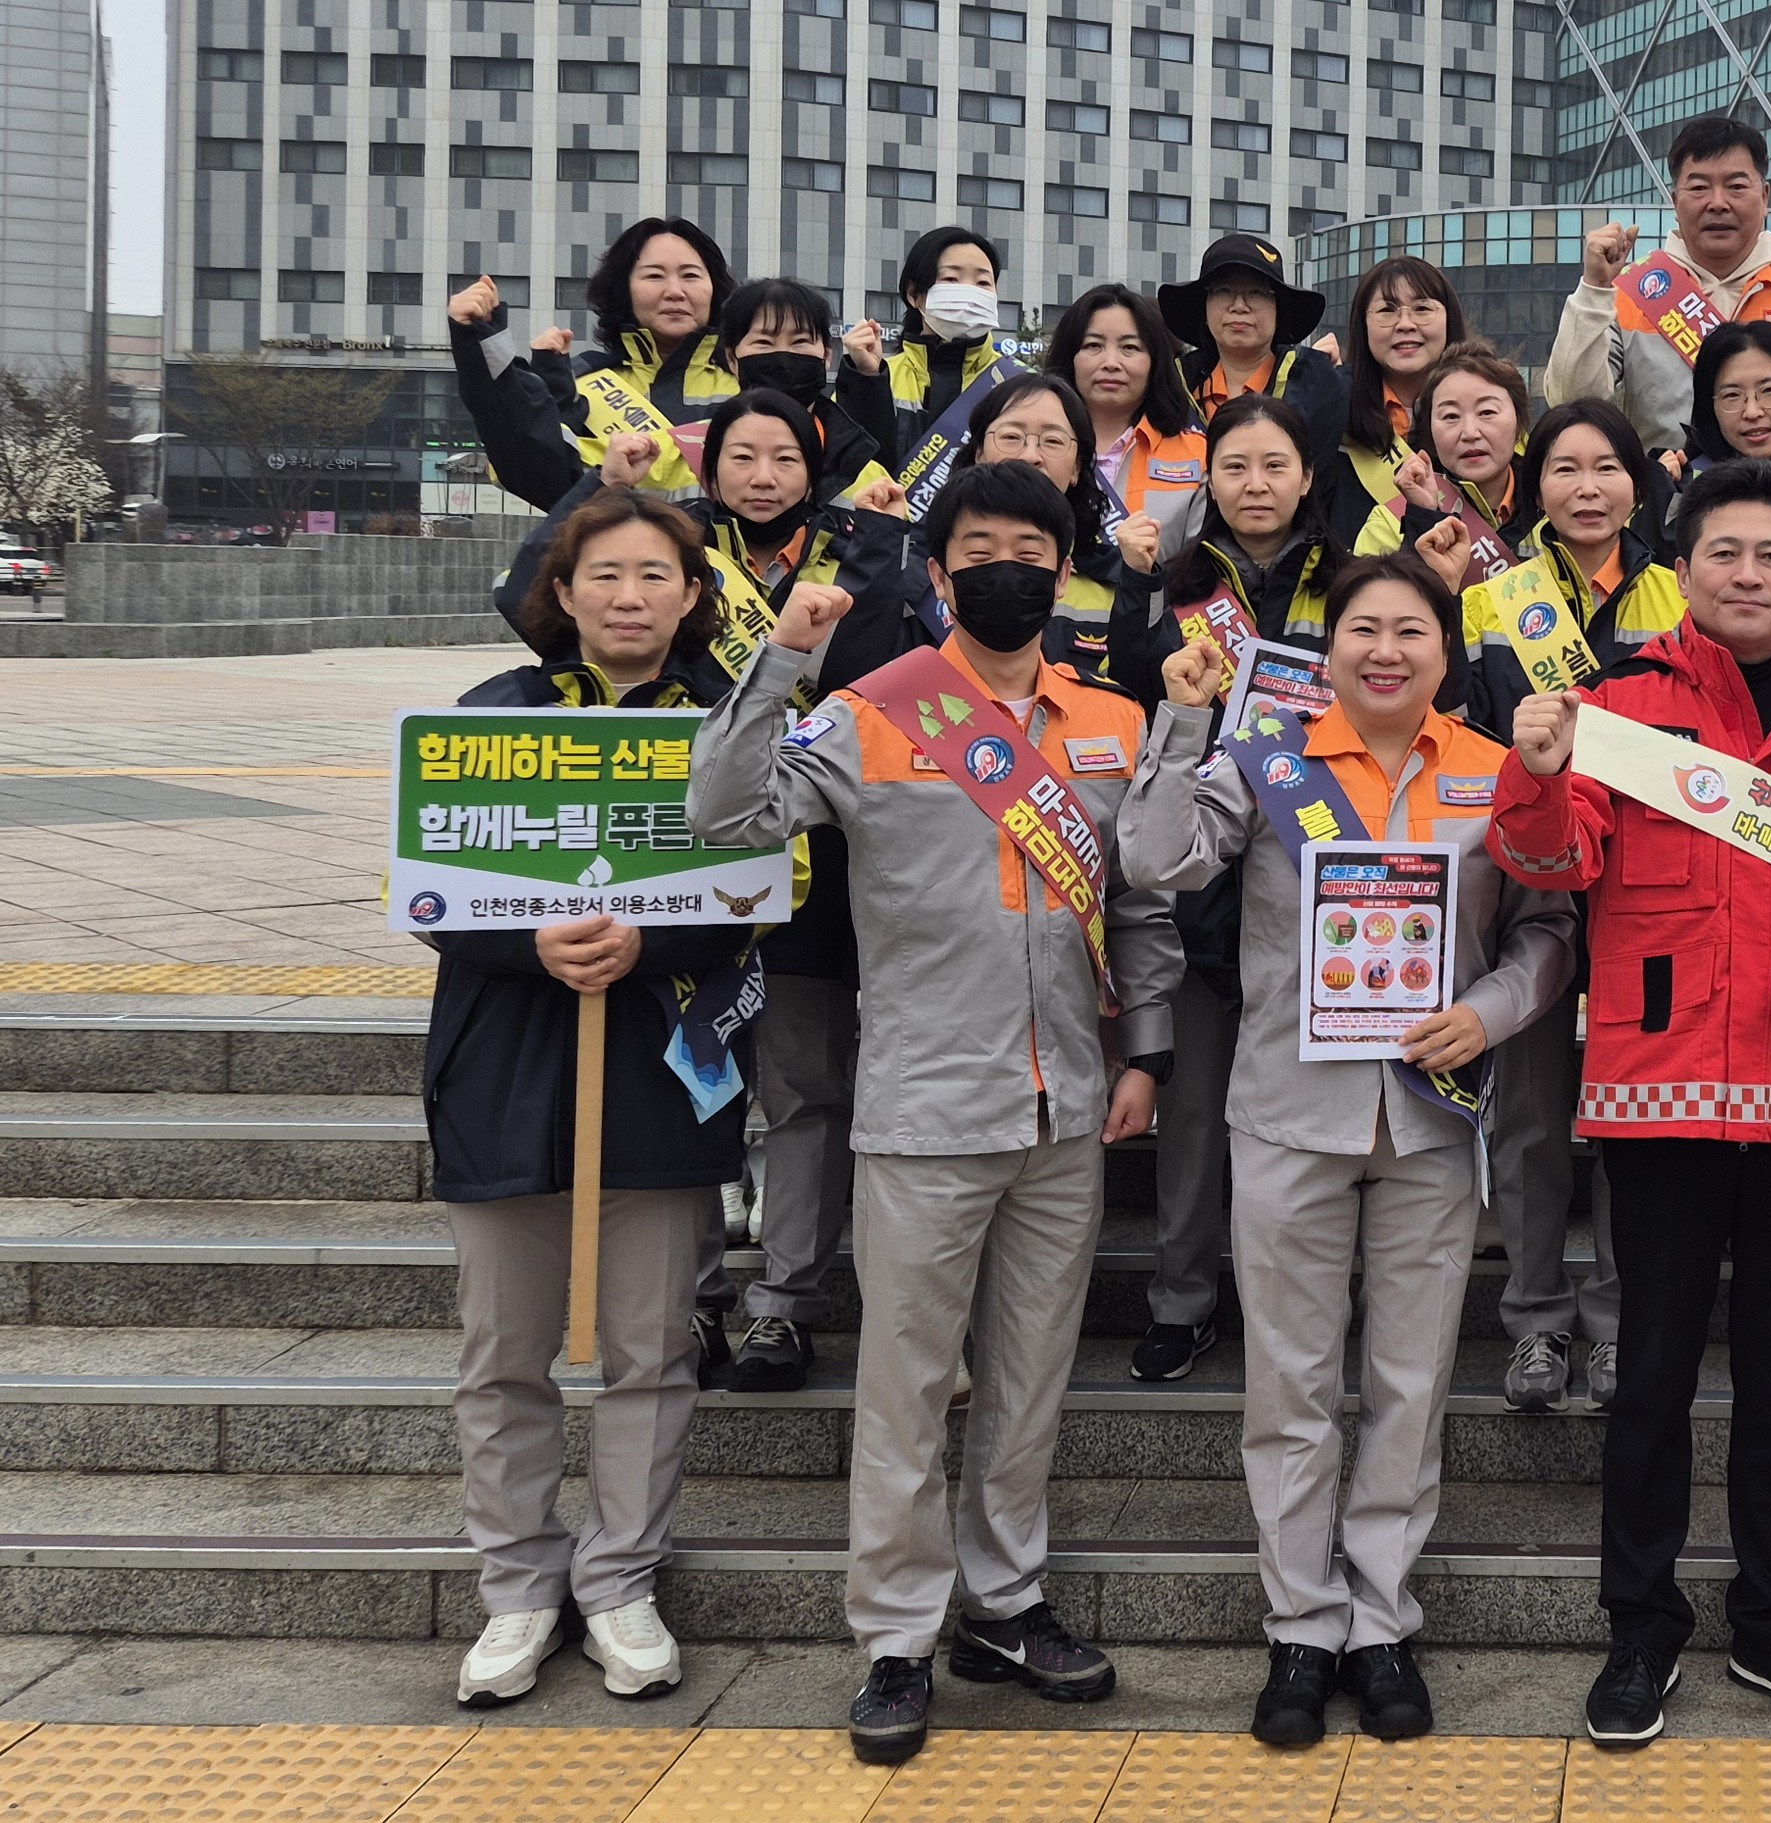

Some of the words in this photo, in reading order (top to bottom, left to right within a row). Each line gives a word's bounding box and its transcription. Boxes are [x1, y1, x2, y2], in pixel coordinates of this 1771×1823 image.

[343, 339, 383, 350] Bronx
[1658, 308, 1703, 360] 화마
[418, 732, 602, 781] 함께하는
[419, 803, 600, 852] 함께누릴
[1026, 773, 1102, 880] 무심코
[1001, 798, 1095, 915] 화마되어
[1321, 866, 1359, 880] 산불은
[1361, 866, 1388, 880] 오직
[470, 897, 604, 919] 인천영종소방서
[609, 893, 702, 915] 의용소방대
[1320, 881, 1371, 896] 예방만이
[1372, 881, 1440, 897] 최선입니다!
